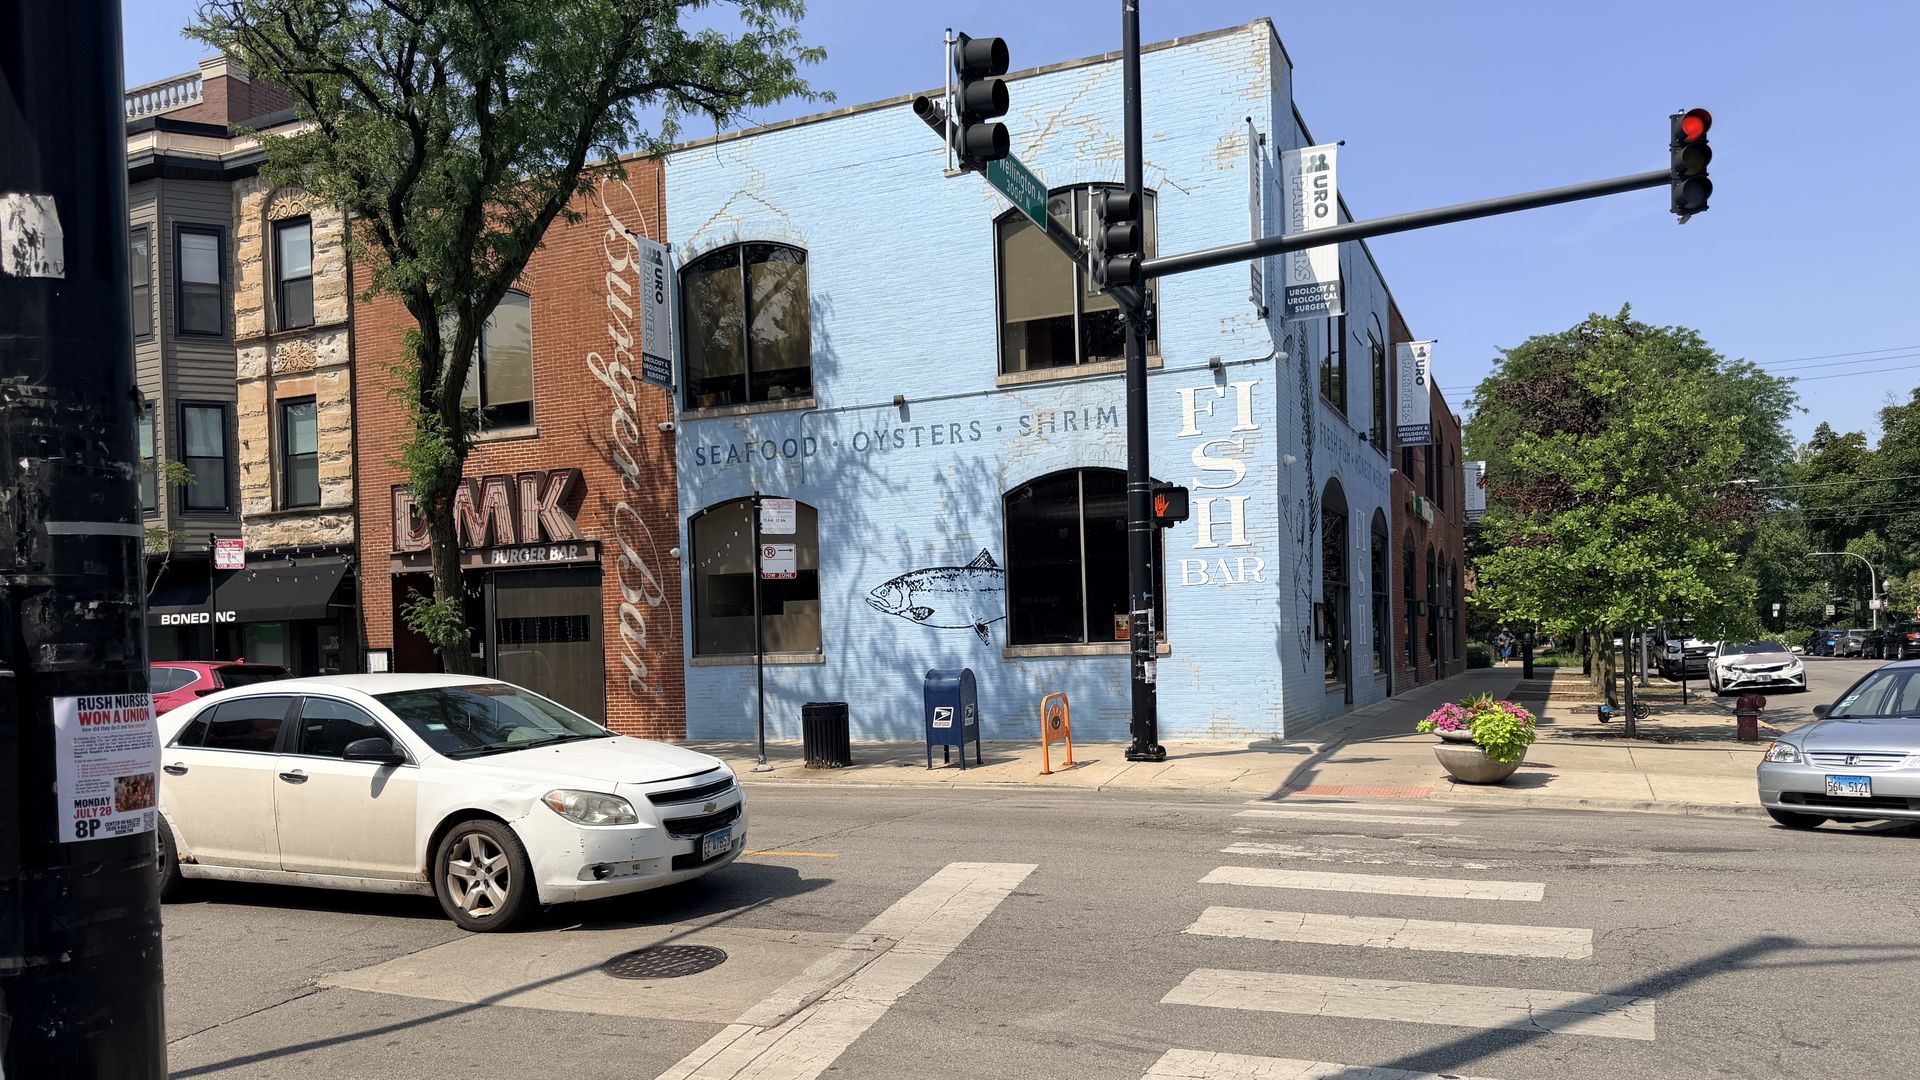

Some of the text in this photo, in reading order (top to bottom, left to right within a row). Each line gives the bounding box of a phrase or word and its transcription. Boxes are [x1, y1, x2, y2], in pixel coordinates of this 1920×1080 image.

[1006, 180, 1031, 210] 3000 N
[1313, 175, 1328, 218] URO
[1292, 175, 1310, 282] PARTERS
[655, 267, 663, 305] URO
[1289, 284, 1336, 297] UROLOGY &
[643, 260, 656, 352] PARTNERS
[1287, 292, 1338, 305] UROLOGICAL
[1295, 301, 1331, 313] SURGERY
[643, 362, 670, 376] UROLOGICAL
[644, 355, 664, 367] UROLOGY
[647, 370, 666, 382] SURGERY
[1415, 360, 1425, 386] URO
[1402, 358, 1413, 424] PARTNERS
[696, 406, 1119, 467] SEAFOOD OYSTERS SHRIM
[392, 468, 587, 552] DMK
[491, 545, 578, 565] BURGER BAR
[1179, 556, 1266, 587] BAR
[161, 611, 236, 625] BONED NC
[77, 694, 149, 711] RUSH NURSES
[78, 708, 150, 726] WON A UNION
[1827, 781, 1869, 793] 564 5121
[74, 797, 110, 809] MONDAY
[73, 806, 98, 819] JULY
[75, 819, 101, 838] 8P
